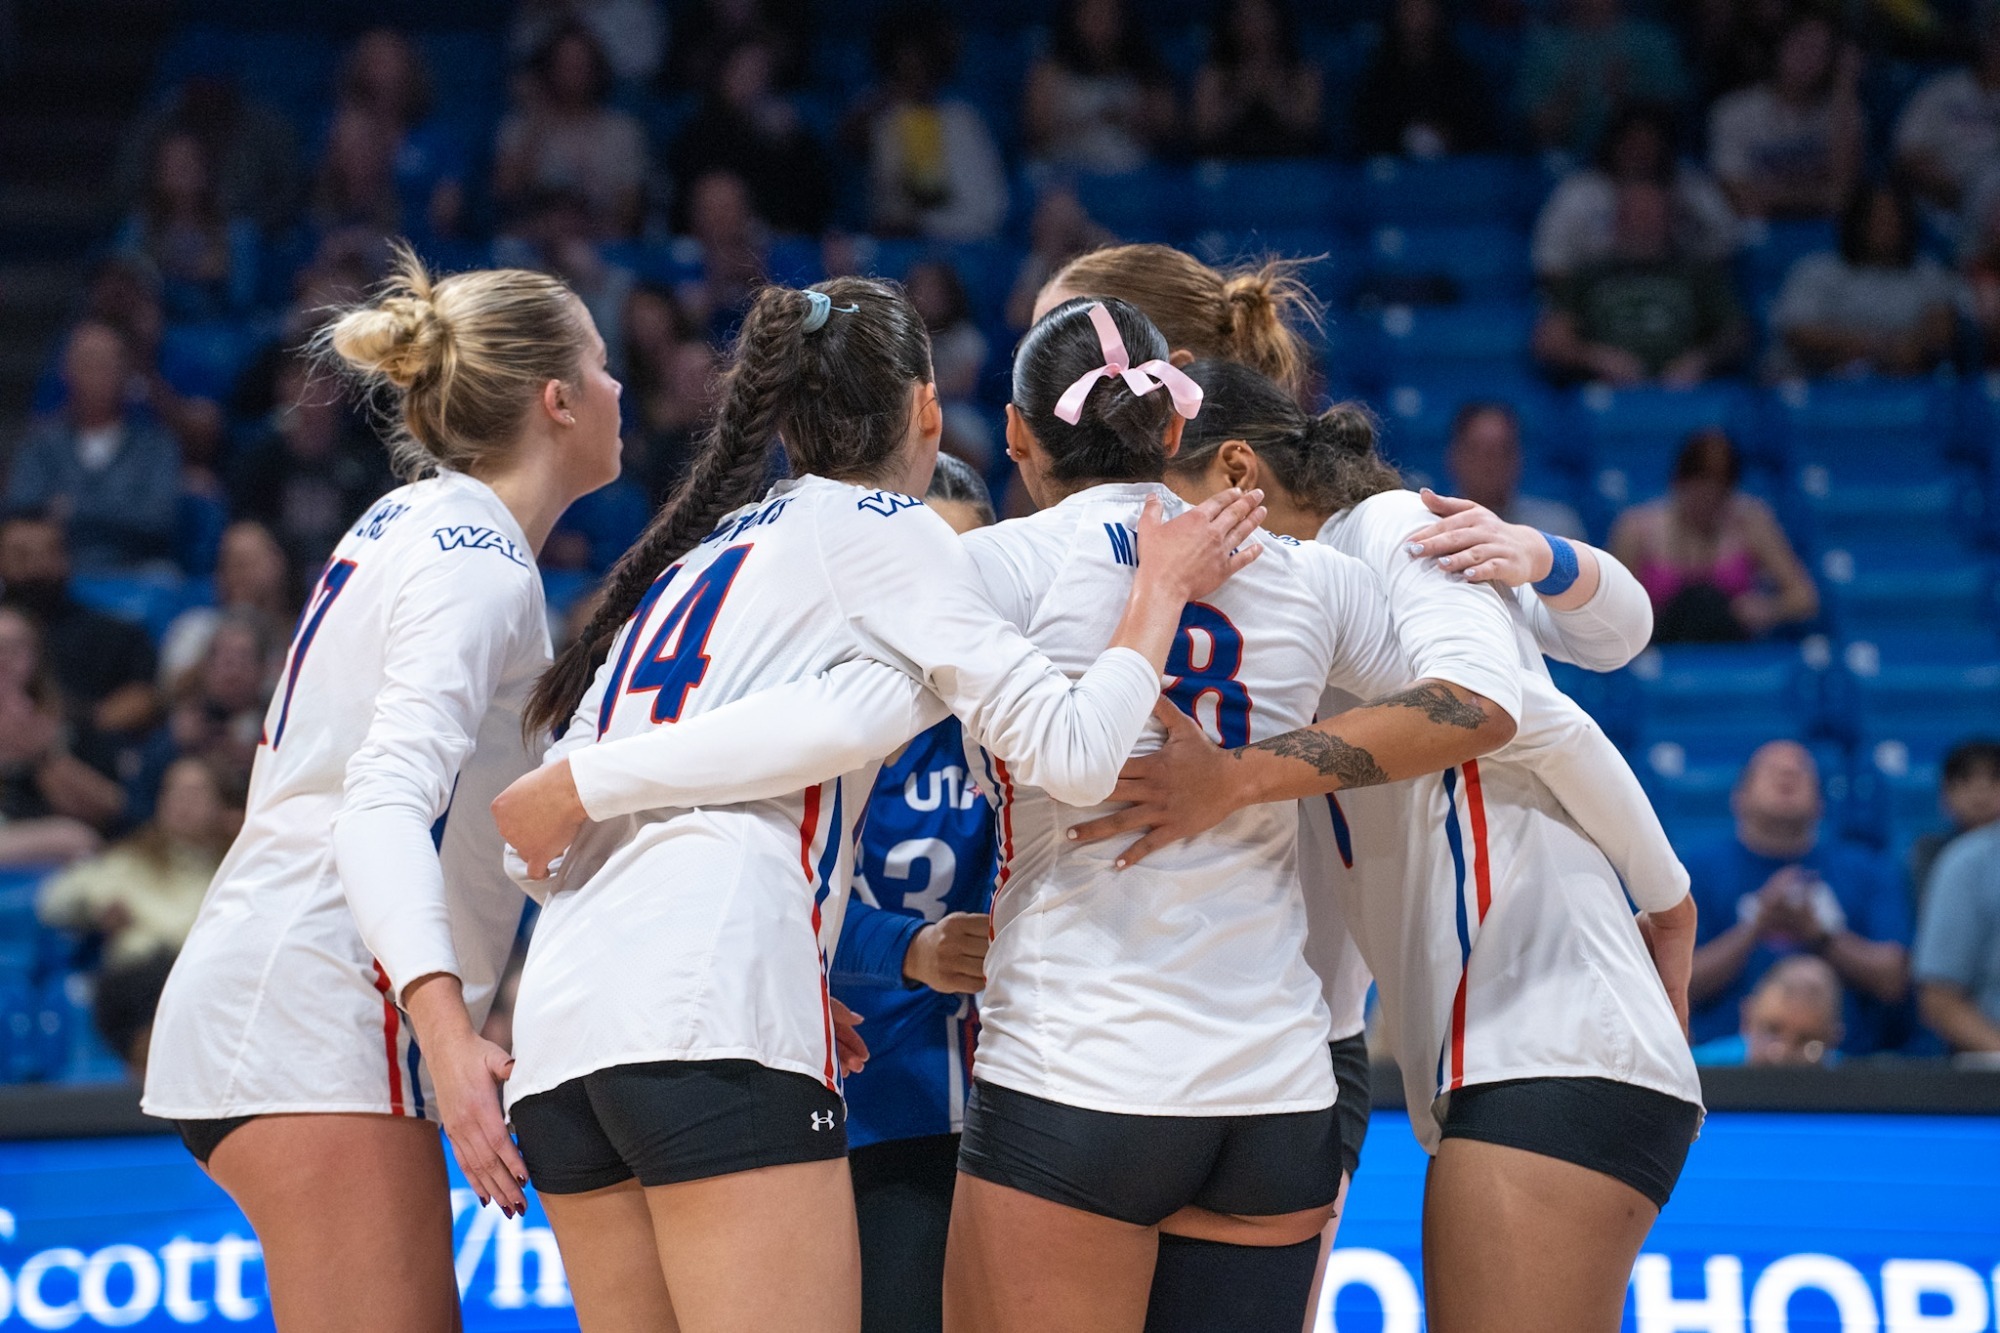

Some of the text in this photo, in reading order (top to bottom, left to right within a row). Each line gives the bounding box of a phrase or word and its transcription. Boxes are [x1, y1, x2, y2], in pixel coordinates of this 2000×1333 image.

[857, 490, 924, 517] W
[597, 541, 755, 742] 14
[1161, 600, 1254, 750] 8
[0, 1206, 264, 1331] cott
[1633, 1252, 2000, 1333] HOP
